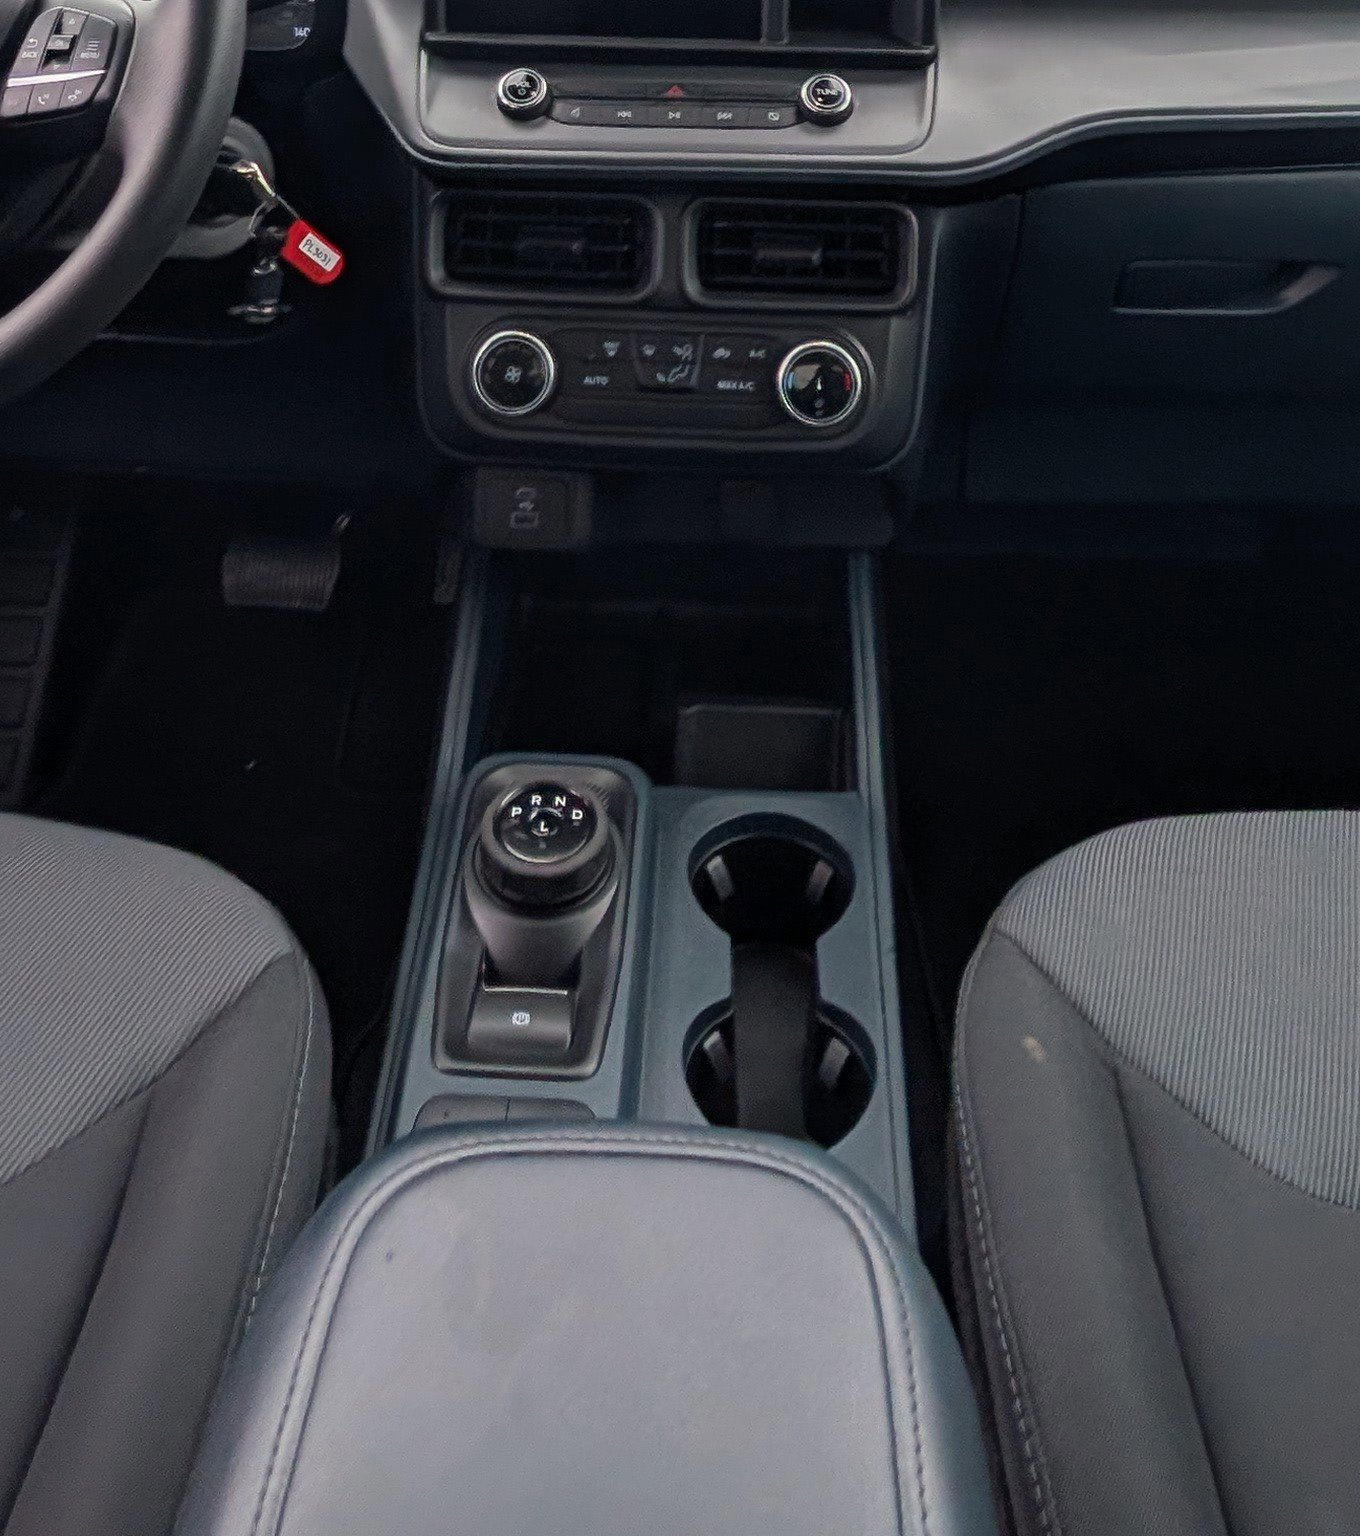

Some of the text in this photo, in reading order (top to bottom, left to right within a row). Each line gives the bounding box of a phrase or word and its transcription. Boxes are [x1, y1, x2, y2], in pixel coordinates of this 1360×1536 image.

[583, 375, 610, 387] AUTO
[531, 794, 542, 806] R
[554, 796, 566, 808] N
[511, 807, 522, 817] P
[571, 810, 583, 821] D
[539, 821, 549, 833] L
